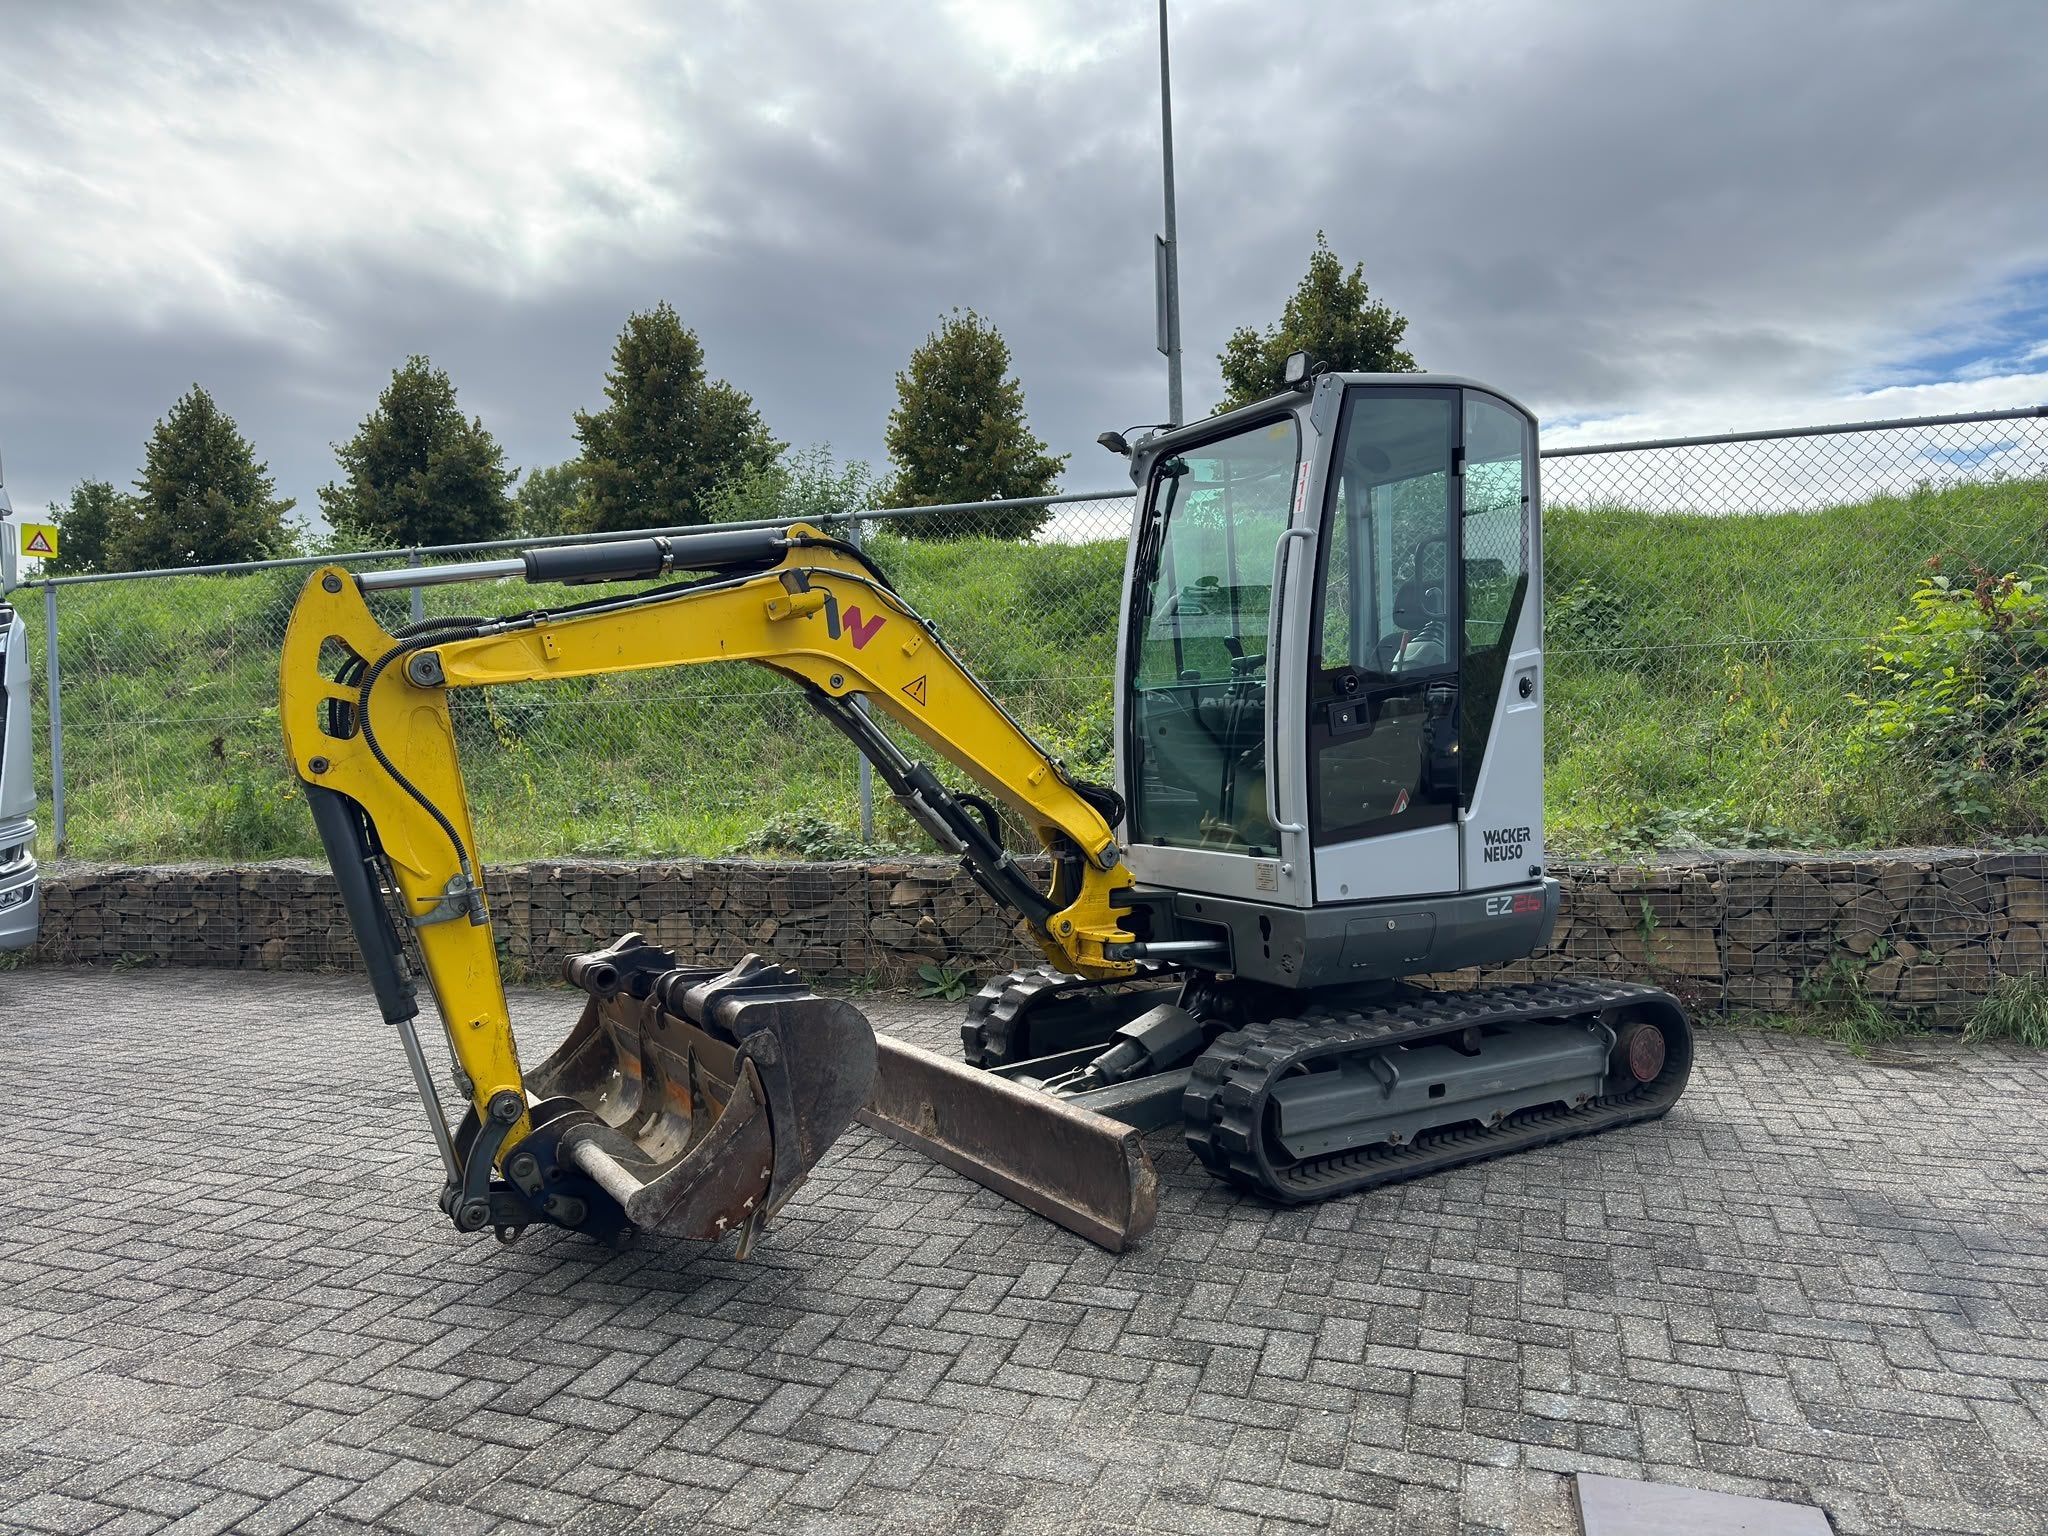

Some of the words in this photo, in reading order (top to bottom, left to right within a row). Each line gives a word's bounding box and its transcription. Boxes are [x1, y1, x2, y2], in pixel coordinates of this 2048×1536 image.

[1483, 827, 1531, 845] WACKER
[1484, 844, 1523, 863] NEUSO
[1486, 895, 1541, 916] EZ26
